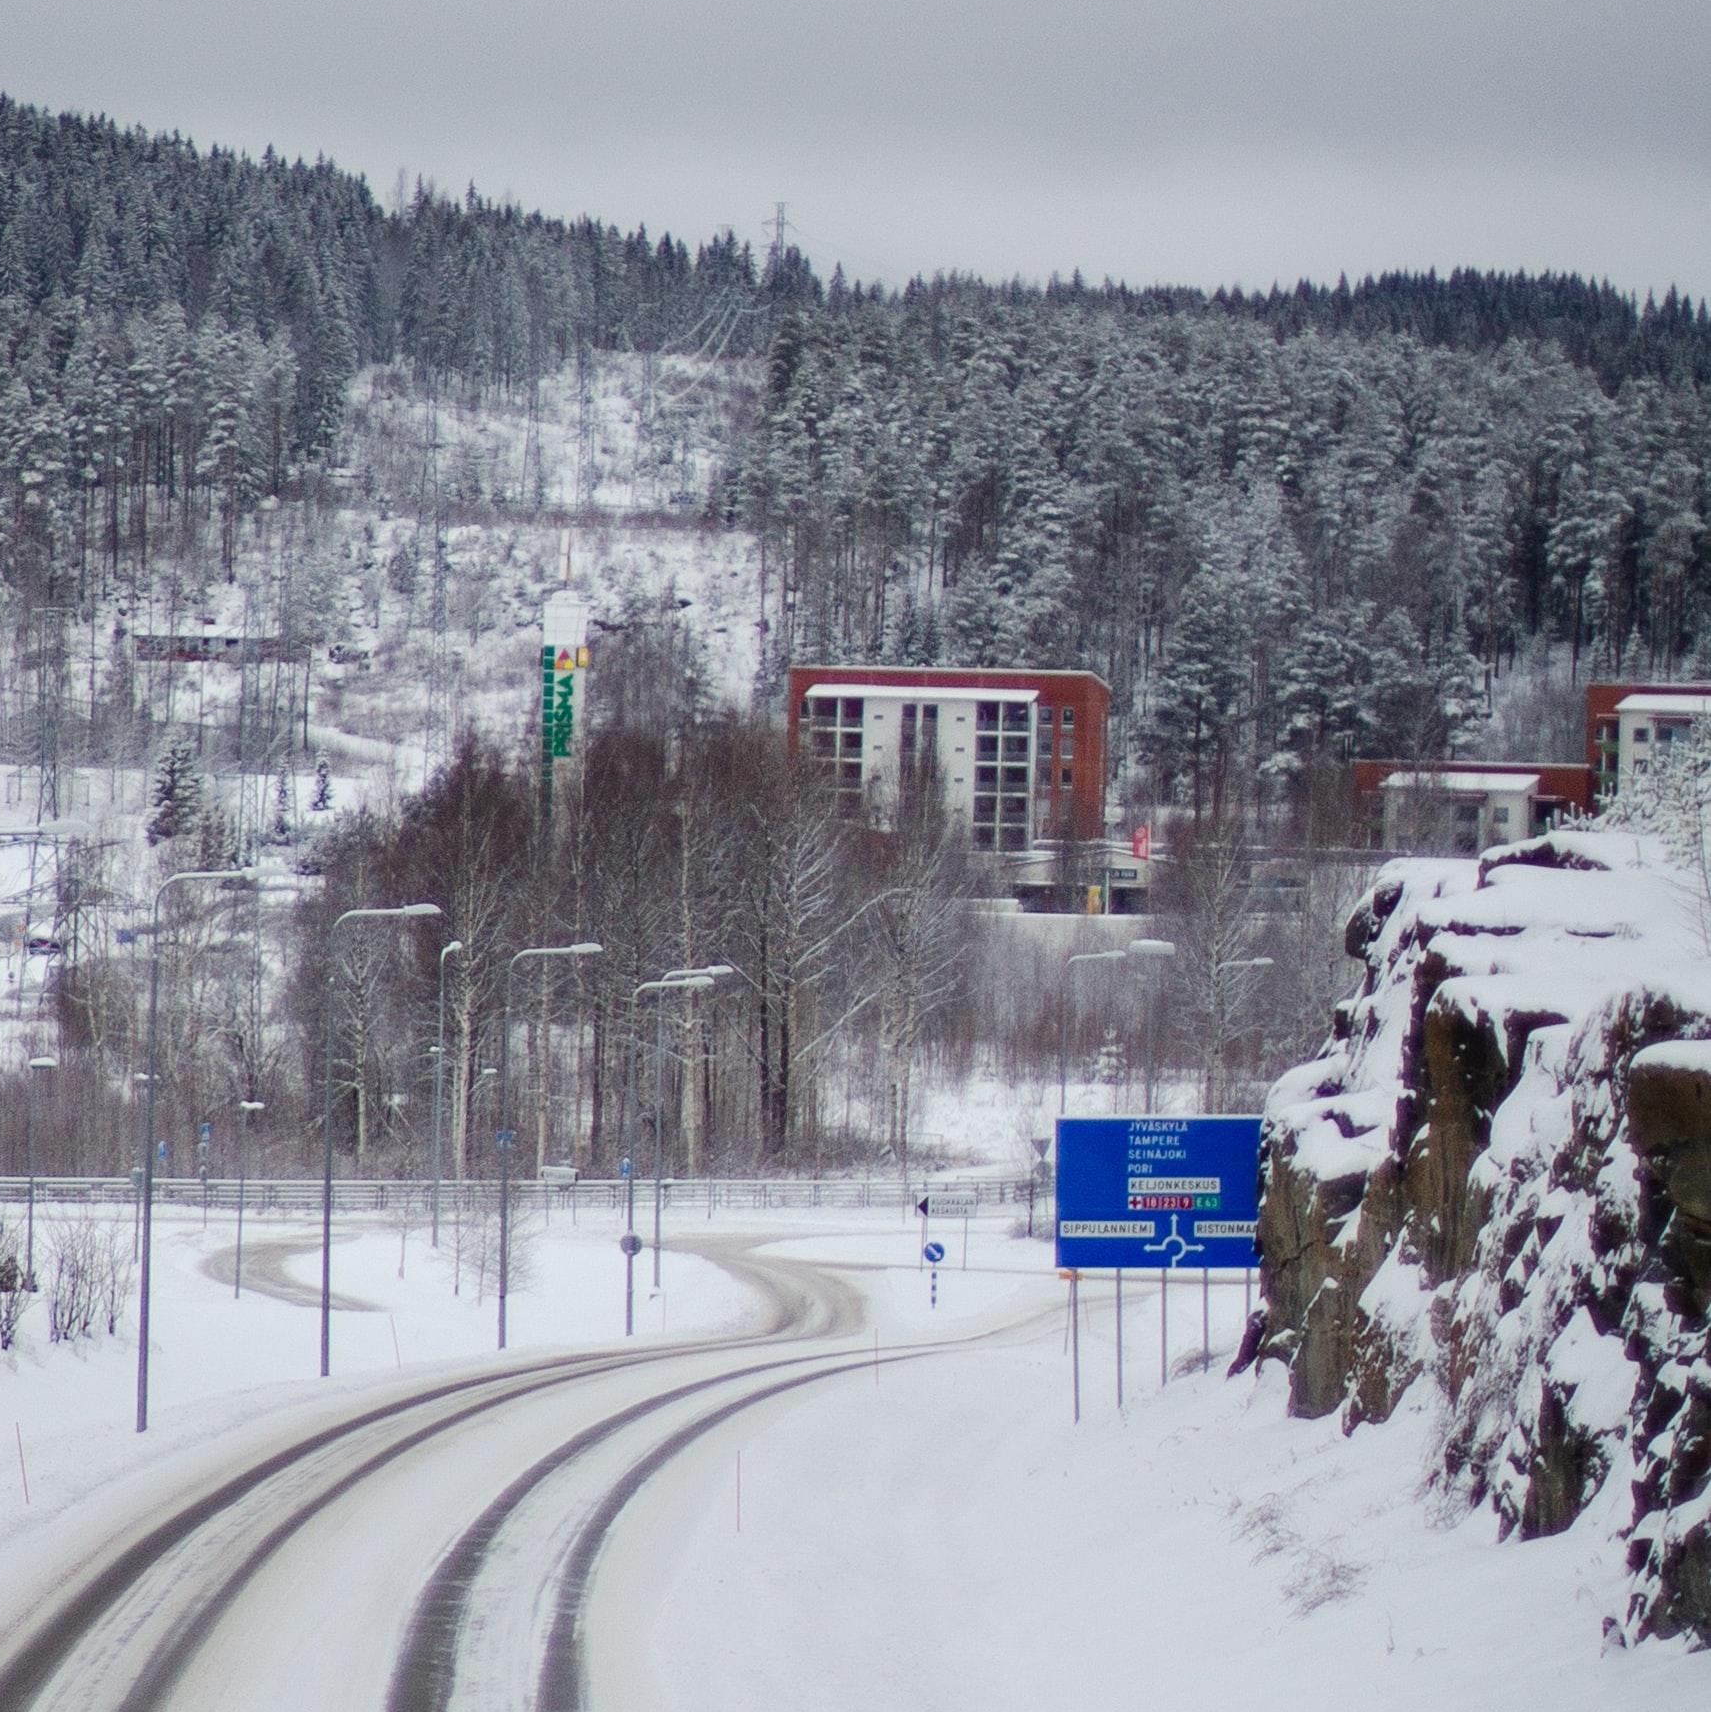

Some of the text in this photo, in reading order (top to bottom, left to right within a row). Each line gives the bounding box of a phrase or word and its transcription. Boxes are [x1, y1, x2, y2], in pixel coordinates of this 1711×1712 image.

[554, 673, 573, 756] PRISMA
[1129, 1120, 1188, 1132] JYVÄSKYLÄ
[1129, 1135, 1180, 1146] TAMPERE
[1128, 1148, 1186, 1159] SEINÄJOKI
[1128, 1163, 1152, 1174] PORI
[1131, 1180, 1218, 1190] KELJONKESKUS
[1146, 1196, 1158, 1208] 18
[1162, 1196, 1177, 1208] 23
[1182, 1196, 1190, 1208] 9
[1063, 1223, 1152, 1234] SIPPULANNIEMI
